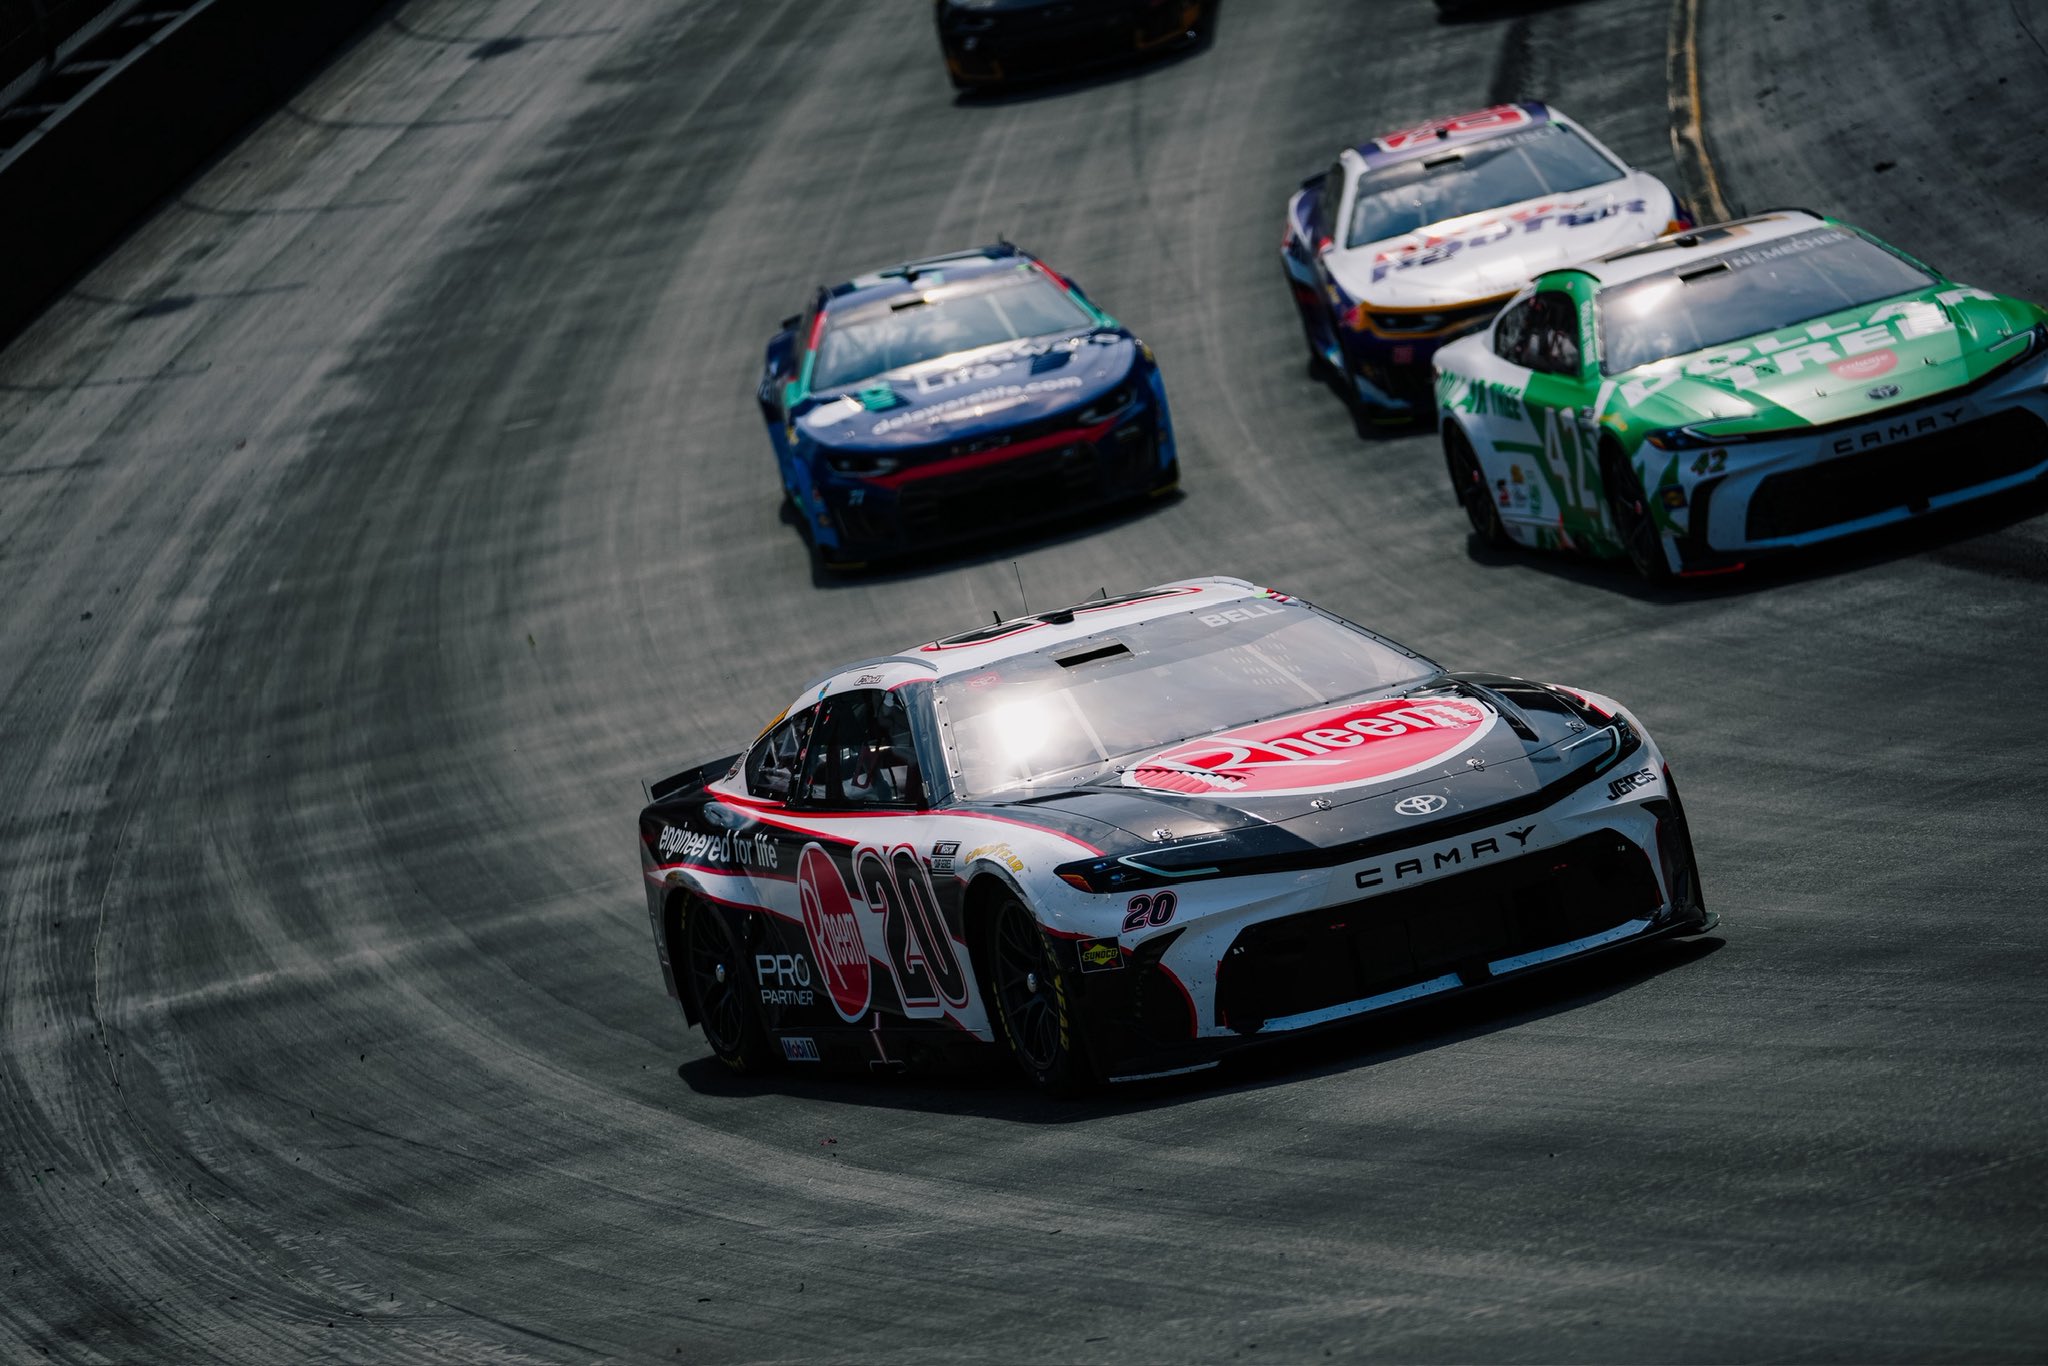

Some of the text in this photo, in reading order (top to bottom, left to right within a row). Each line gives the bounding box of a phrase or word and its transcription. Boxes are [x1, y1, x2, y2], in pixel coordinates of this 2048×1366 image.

[1833, 407, 1964, 455] CAMRY
[1691, 447, 1728, 475] 42
[1198, 604, 1287, 628] BELL
[1146, 704, 1478, 791] Rheem
[659, 821, 732, 862] engineered
[733, 830, 753, 865] for
[1355, 824, 1537, 889] CAMRY
[801, 851, 869, 990] Rheem
[853, 843, 969, 1019] 20
[1121, 890, 1177, 933] 20
[755, 953, 811, 987] PRO
[1084, 949, 1117, 961] SUNOCO
[761, 989, 814, 1007] PARTNER
[782, 1039, 808, 1058] Mobil
